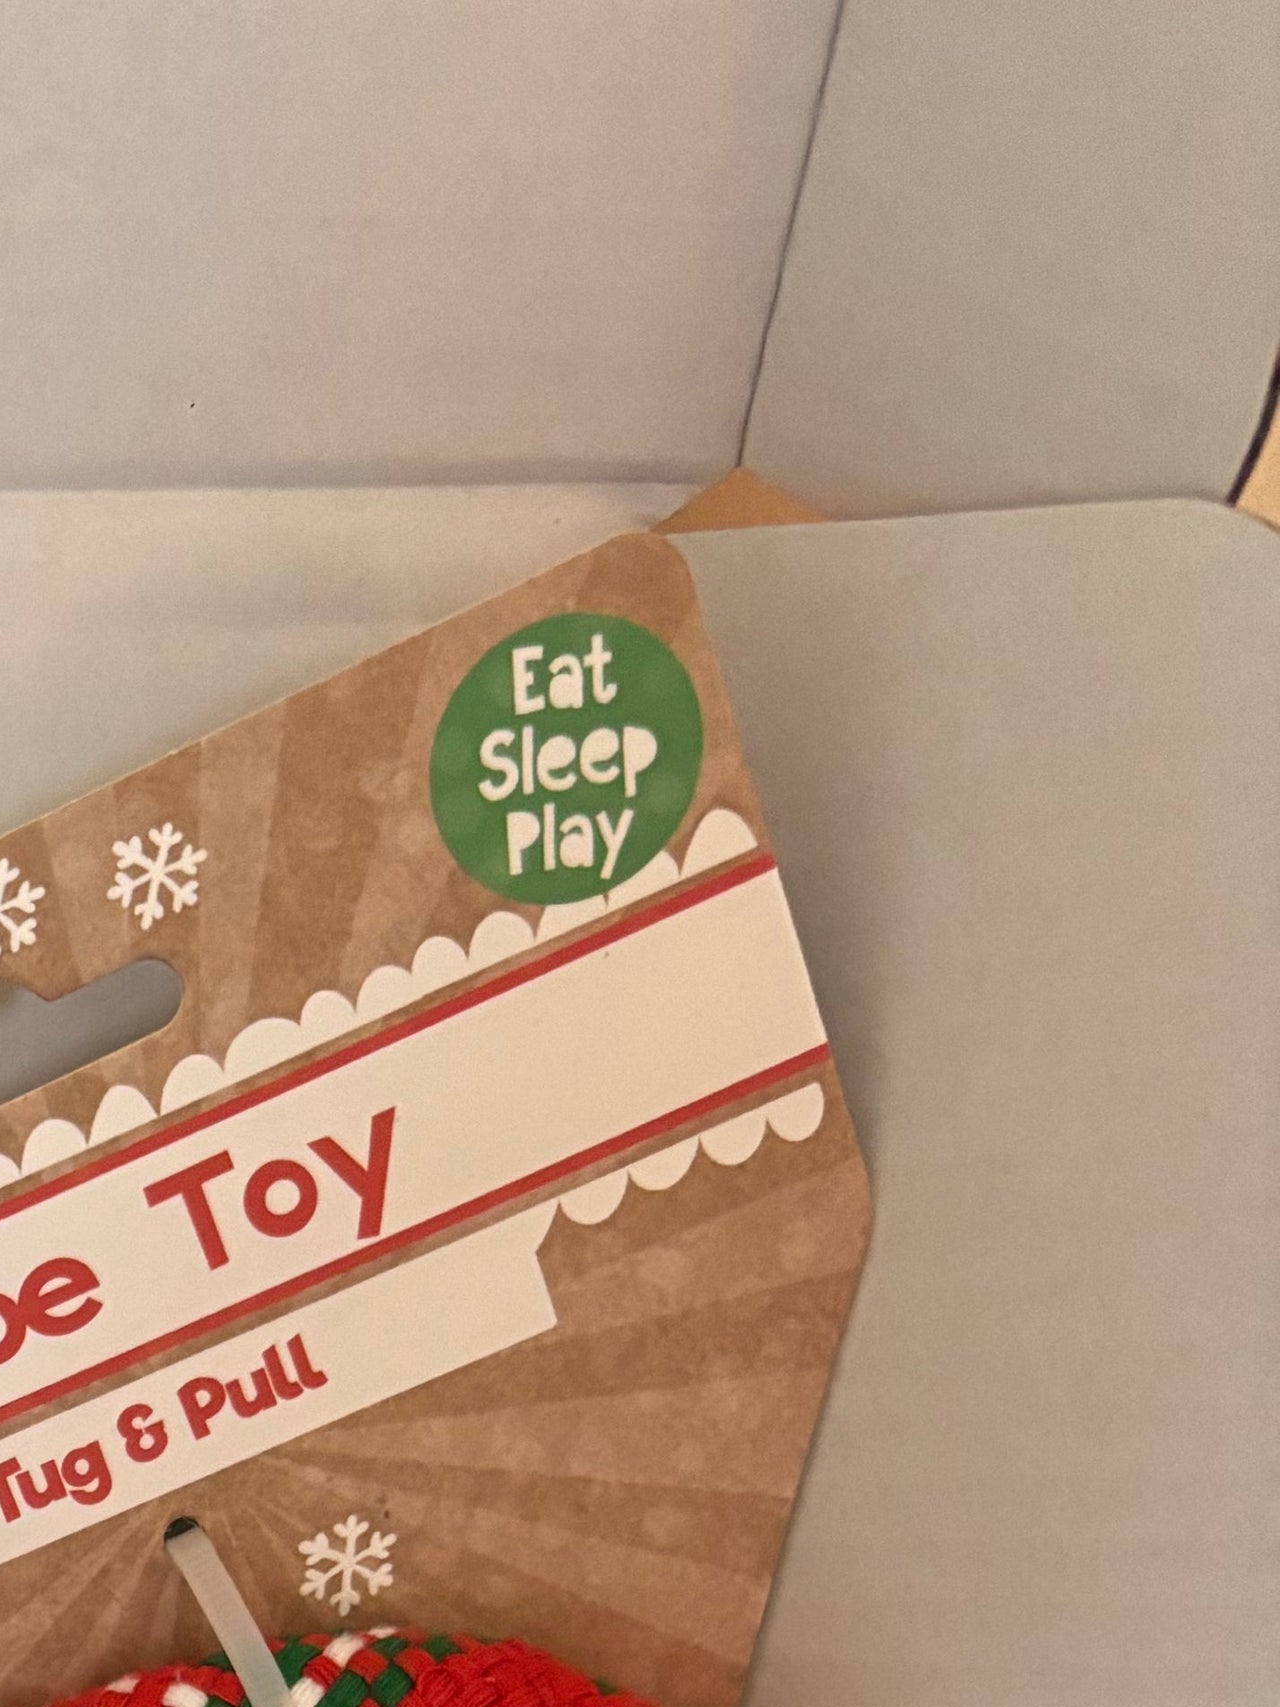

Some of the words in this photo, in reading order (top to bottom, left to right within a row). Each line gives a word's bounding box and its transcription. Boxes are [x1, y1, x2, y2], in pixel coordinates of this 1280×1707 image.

[512, 634, 617, 715] Eat
[478, 725, 658, 801] Sleep
[507, 802, 634, 879] Play
[143, 1106, 396, 1271] Toy
[116, 1402, 169, 1462] &
[176, 1334, 328, 1441] Pull
